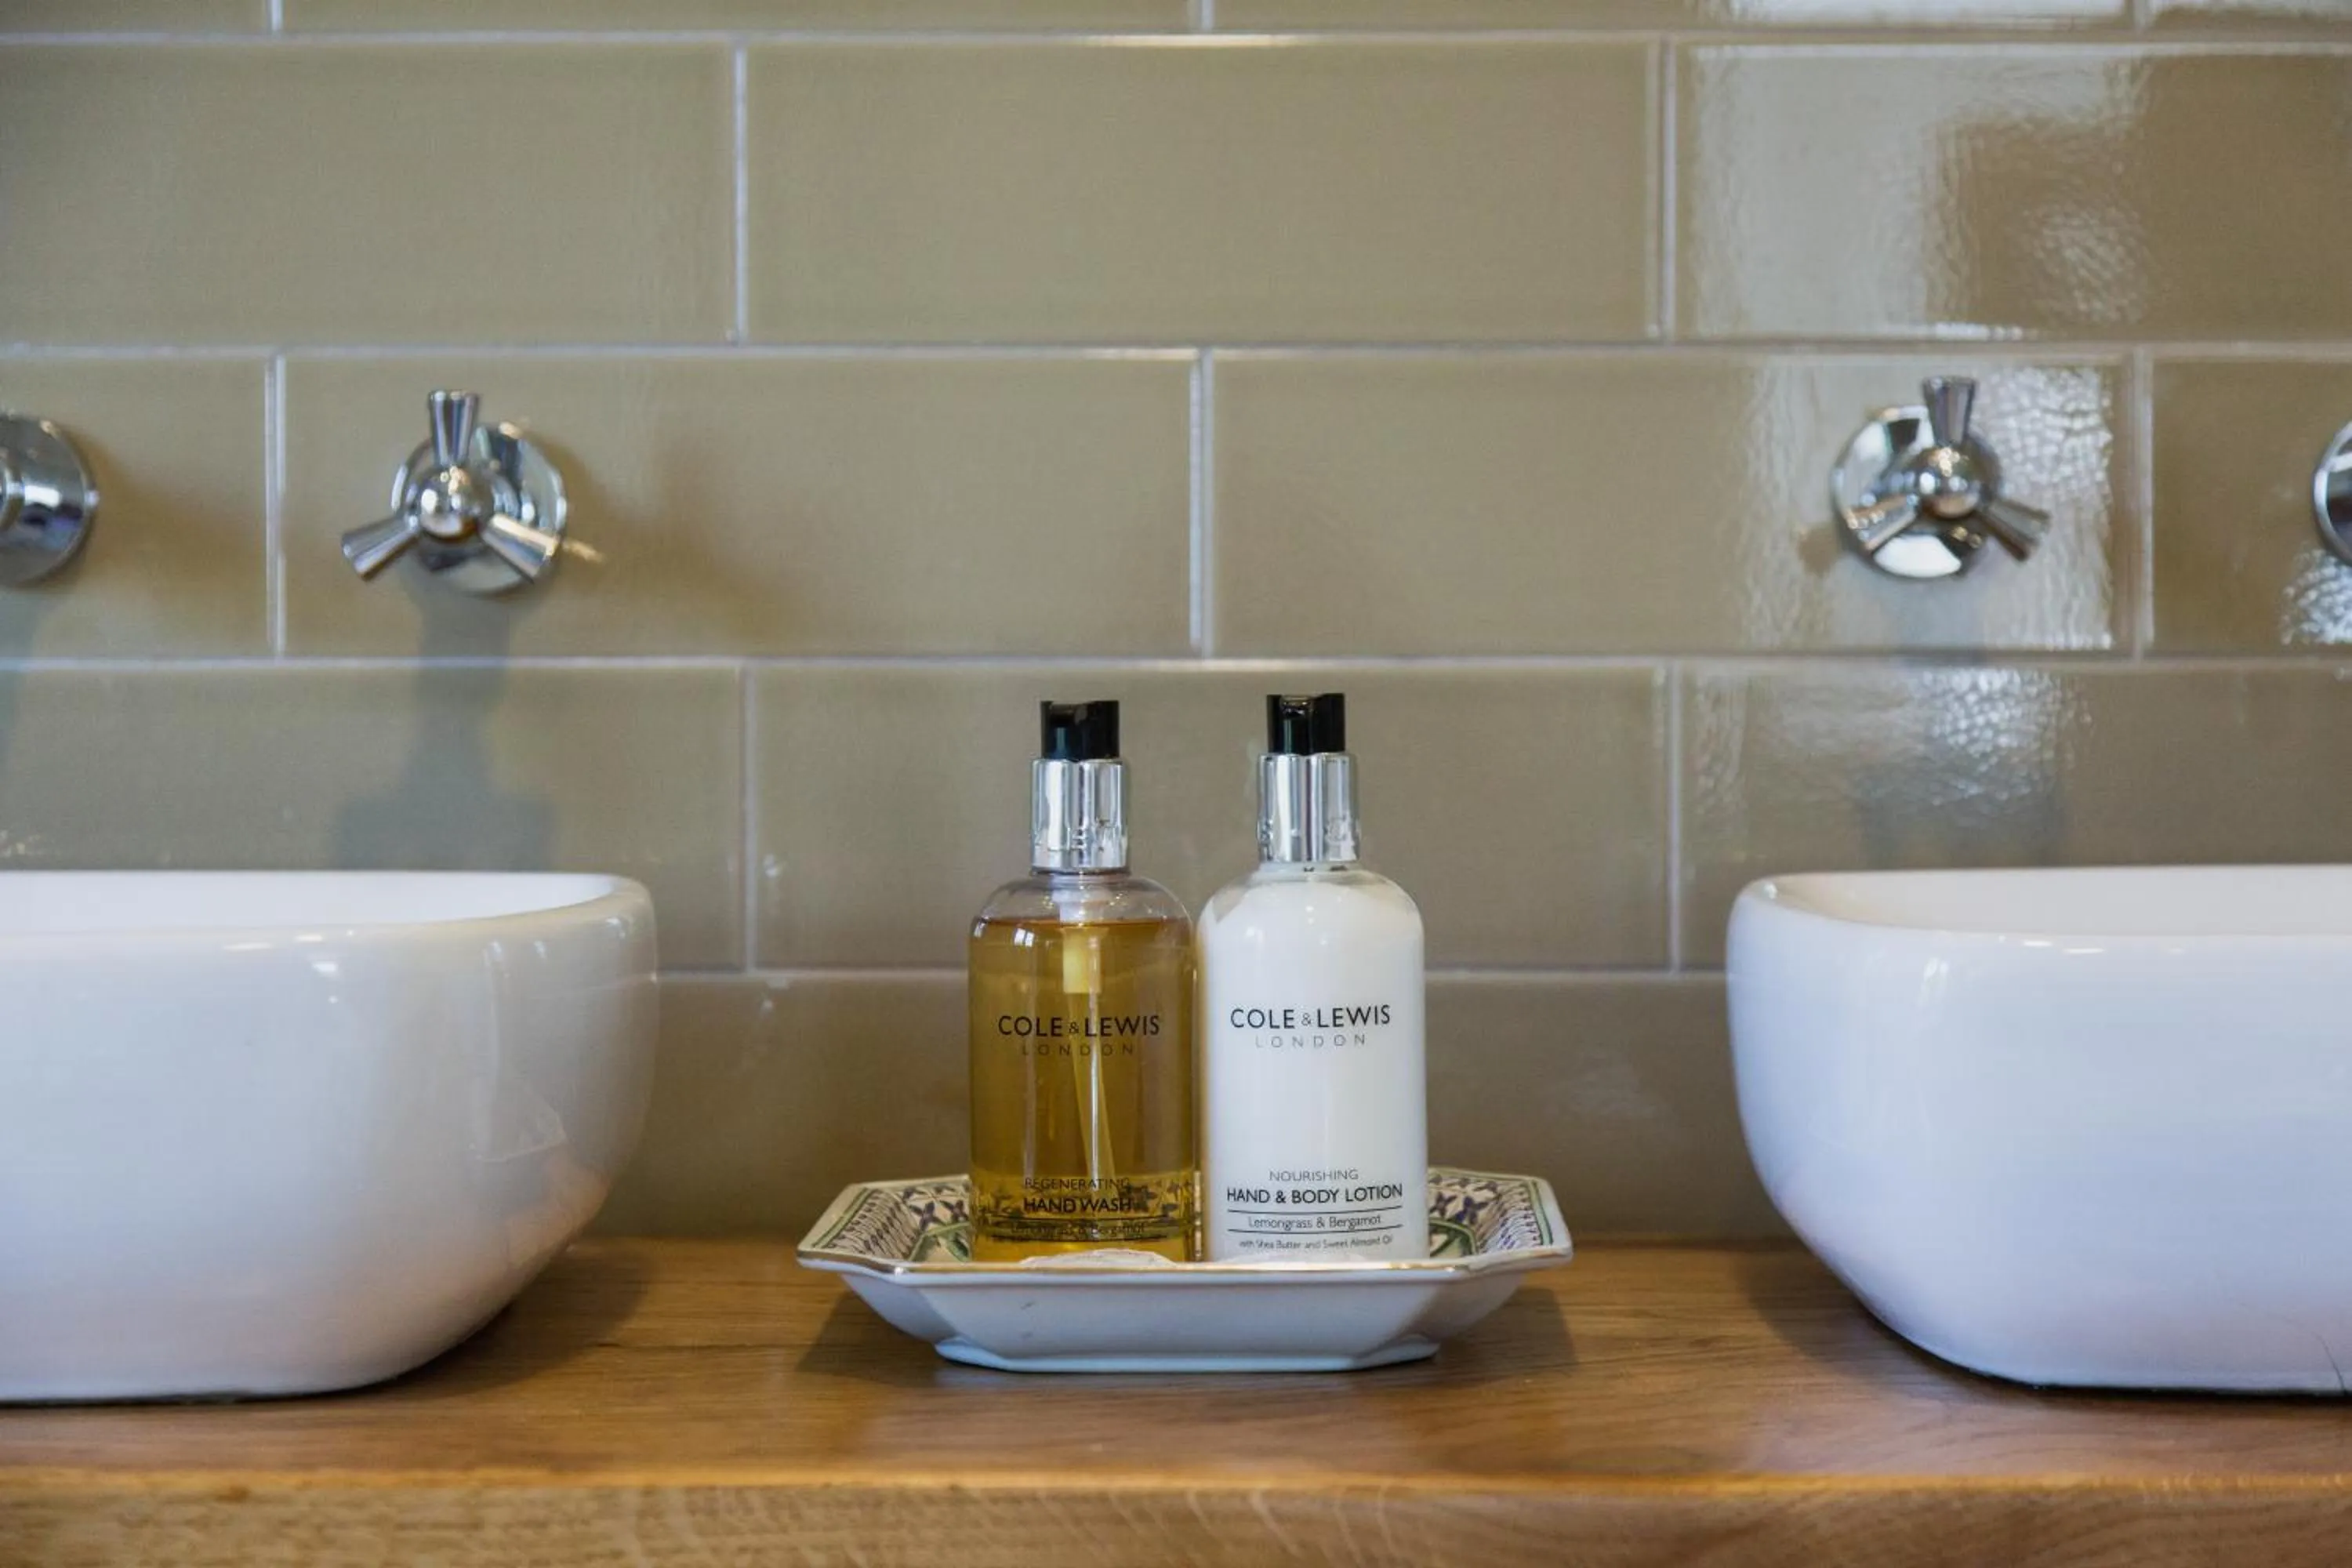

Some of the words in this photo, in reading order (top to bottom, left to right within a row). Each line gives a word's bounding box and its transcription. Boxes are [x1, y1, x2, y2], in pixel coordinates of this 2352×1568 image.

[1230, 1007, 1295, 1029] COLE
[1301, 1012, 1312, 1026] &
[1317, 1004, 1391, 1028] LEWIS
[998, 1015, 1062, 1037] COLE
[1069, 1022, 1079, 1034] &
[1085, 1014, 1160, 1036] LEWIS
[1255, 1033, 1366, 1048] LONDON
[1022, 1043, 1134, 1056] LONDON
[1024, 1177, 1130, 1191] REGENERATING
[1269, 1169, 1359, 1182] NOURISHING
[1227, 1186, 1271, 1204] HAND
[1276, 1189, 1287, 1203] &
[1291, 1188, 1340, 1204] BODY
[1345, 1182, 1403, 1203] LOTION
[1023, 1197, 1076, 1214] HAND
[1080, 1197, 1132, 1213] WASH
[1248, 1215, 1313, 1232] Lemongrass
[1316, 1217, 1326, 1229] &
[1330, 1214, 1381, 1231] Bergamot
